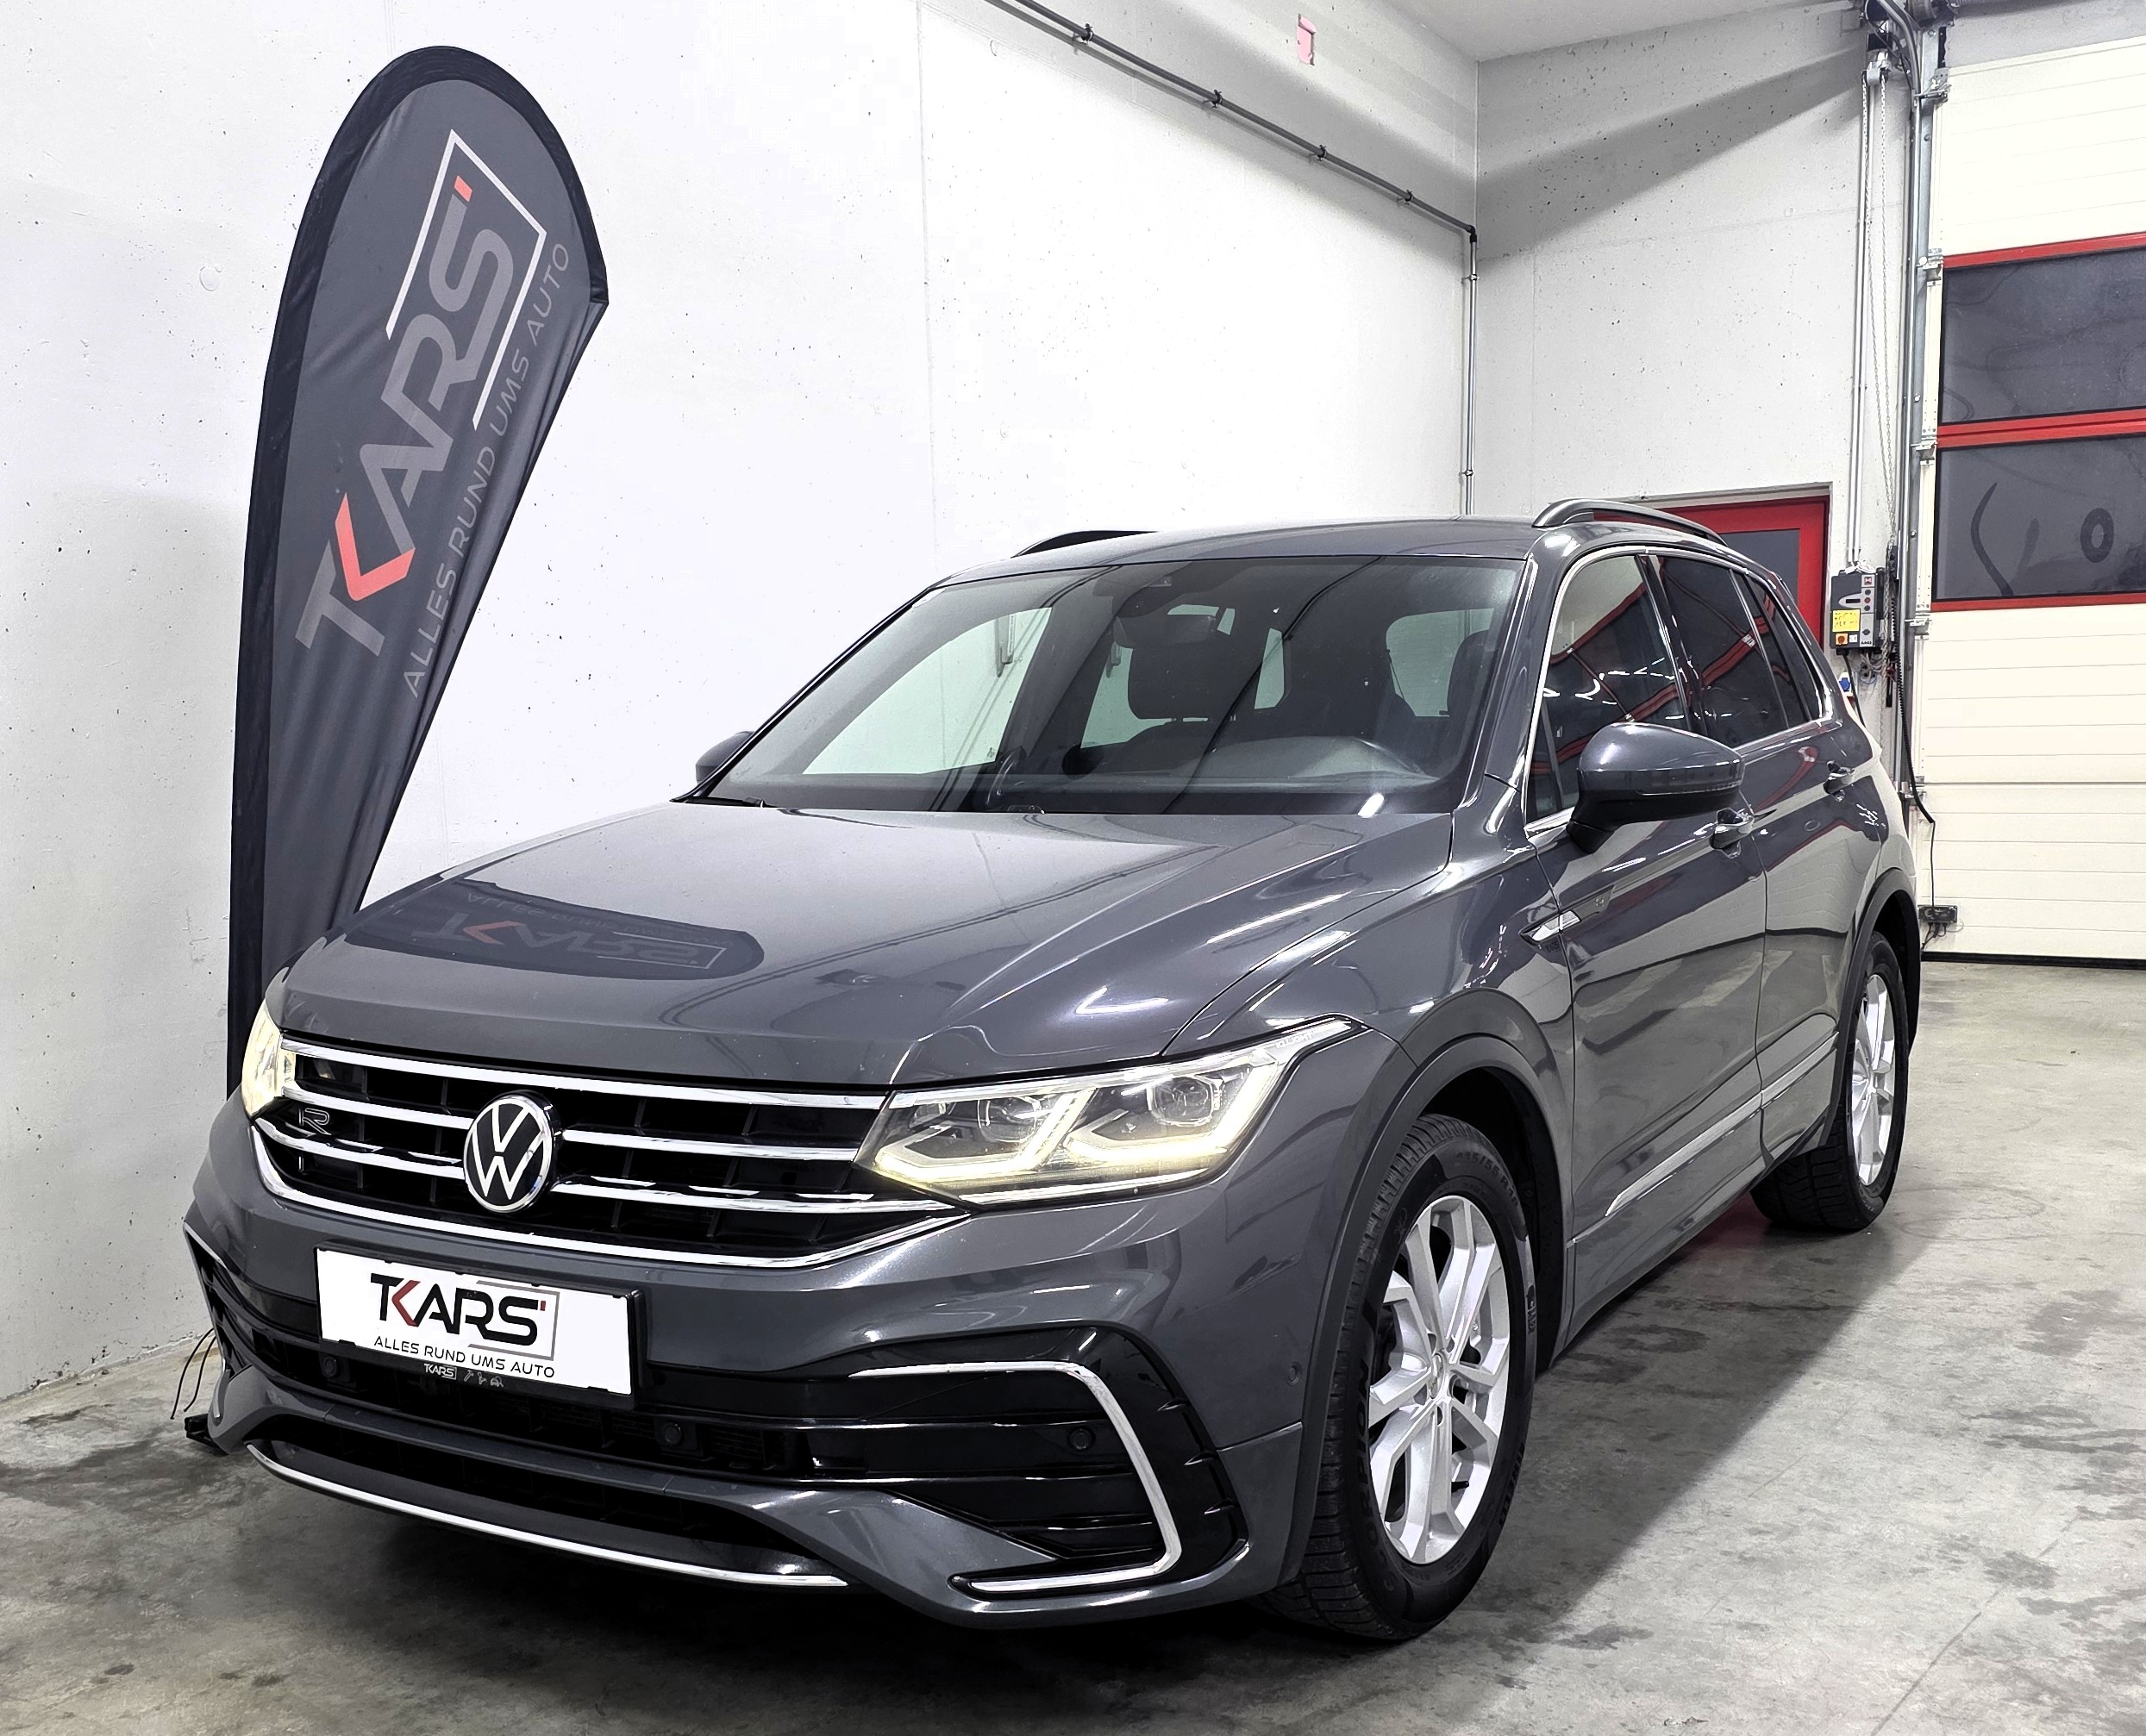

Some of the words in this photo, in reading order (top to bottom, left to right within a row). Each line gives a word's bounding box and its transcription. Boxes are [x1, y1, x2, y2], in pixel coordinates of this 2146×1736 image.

[402, 566, 457, 699] ALLES
[451, 446, 497, 561] RUND
[493, 348, 529, 438] UMS
[527, 242, 570, 338] AUTO
[469, 1099, 549, 1207] VW
[374, 1335, 420, 1355] ALLES
[423, 1346, 466, 1364] RUND
[471, 1355, 506, 1371] UMS
[510, 1361, 555, 1377] AUTO
